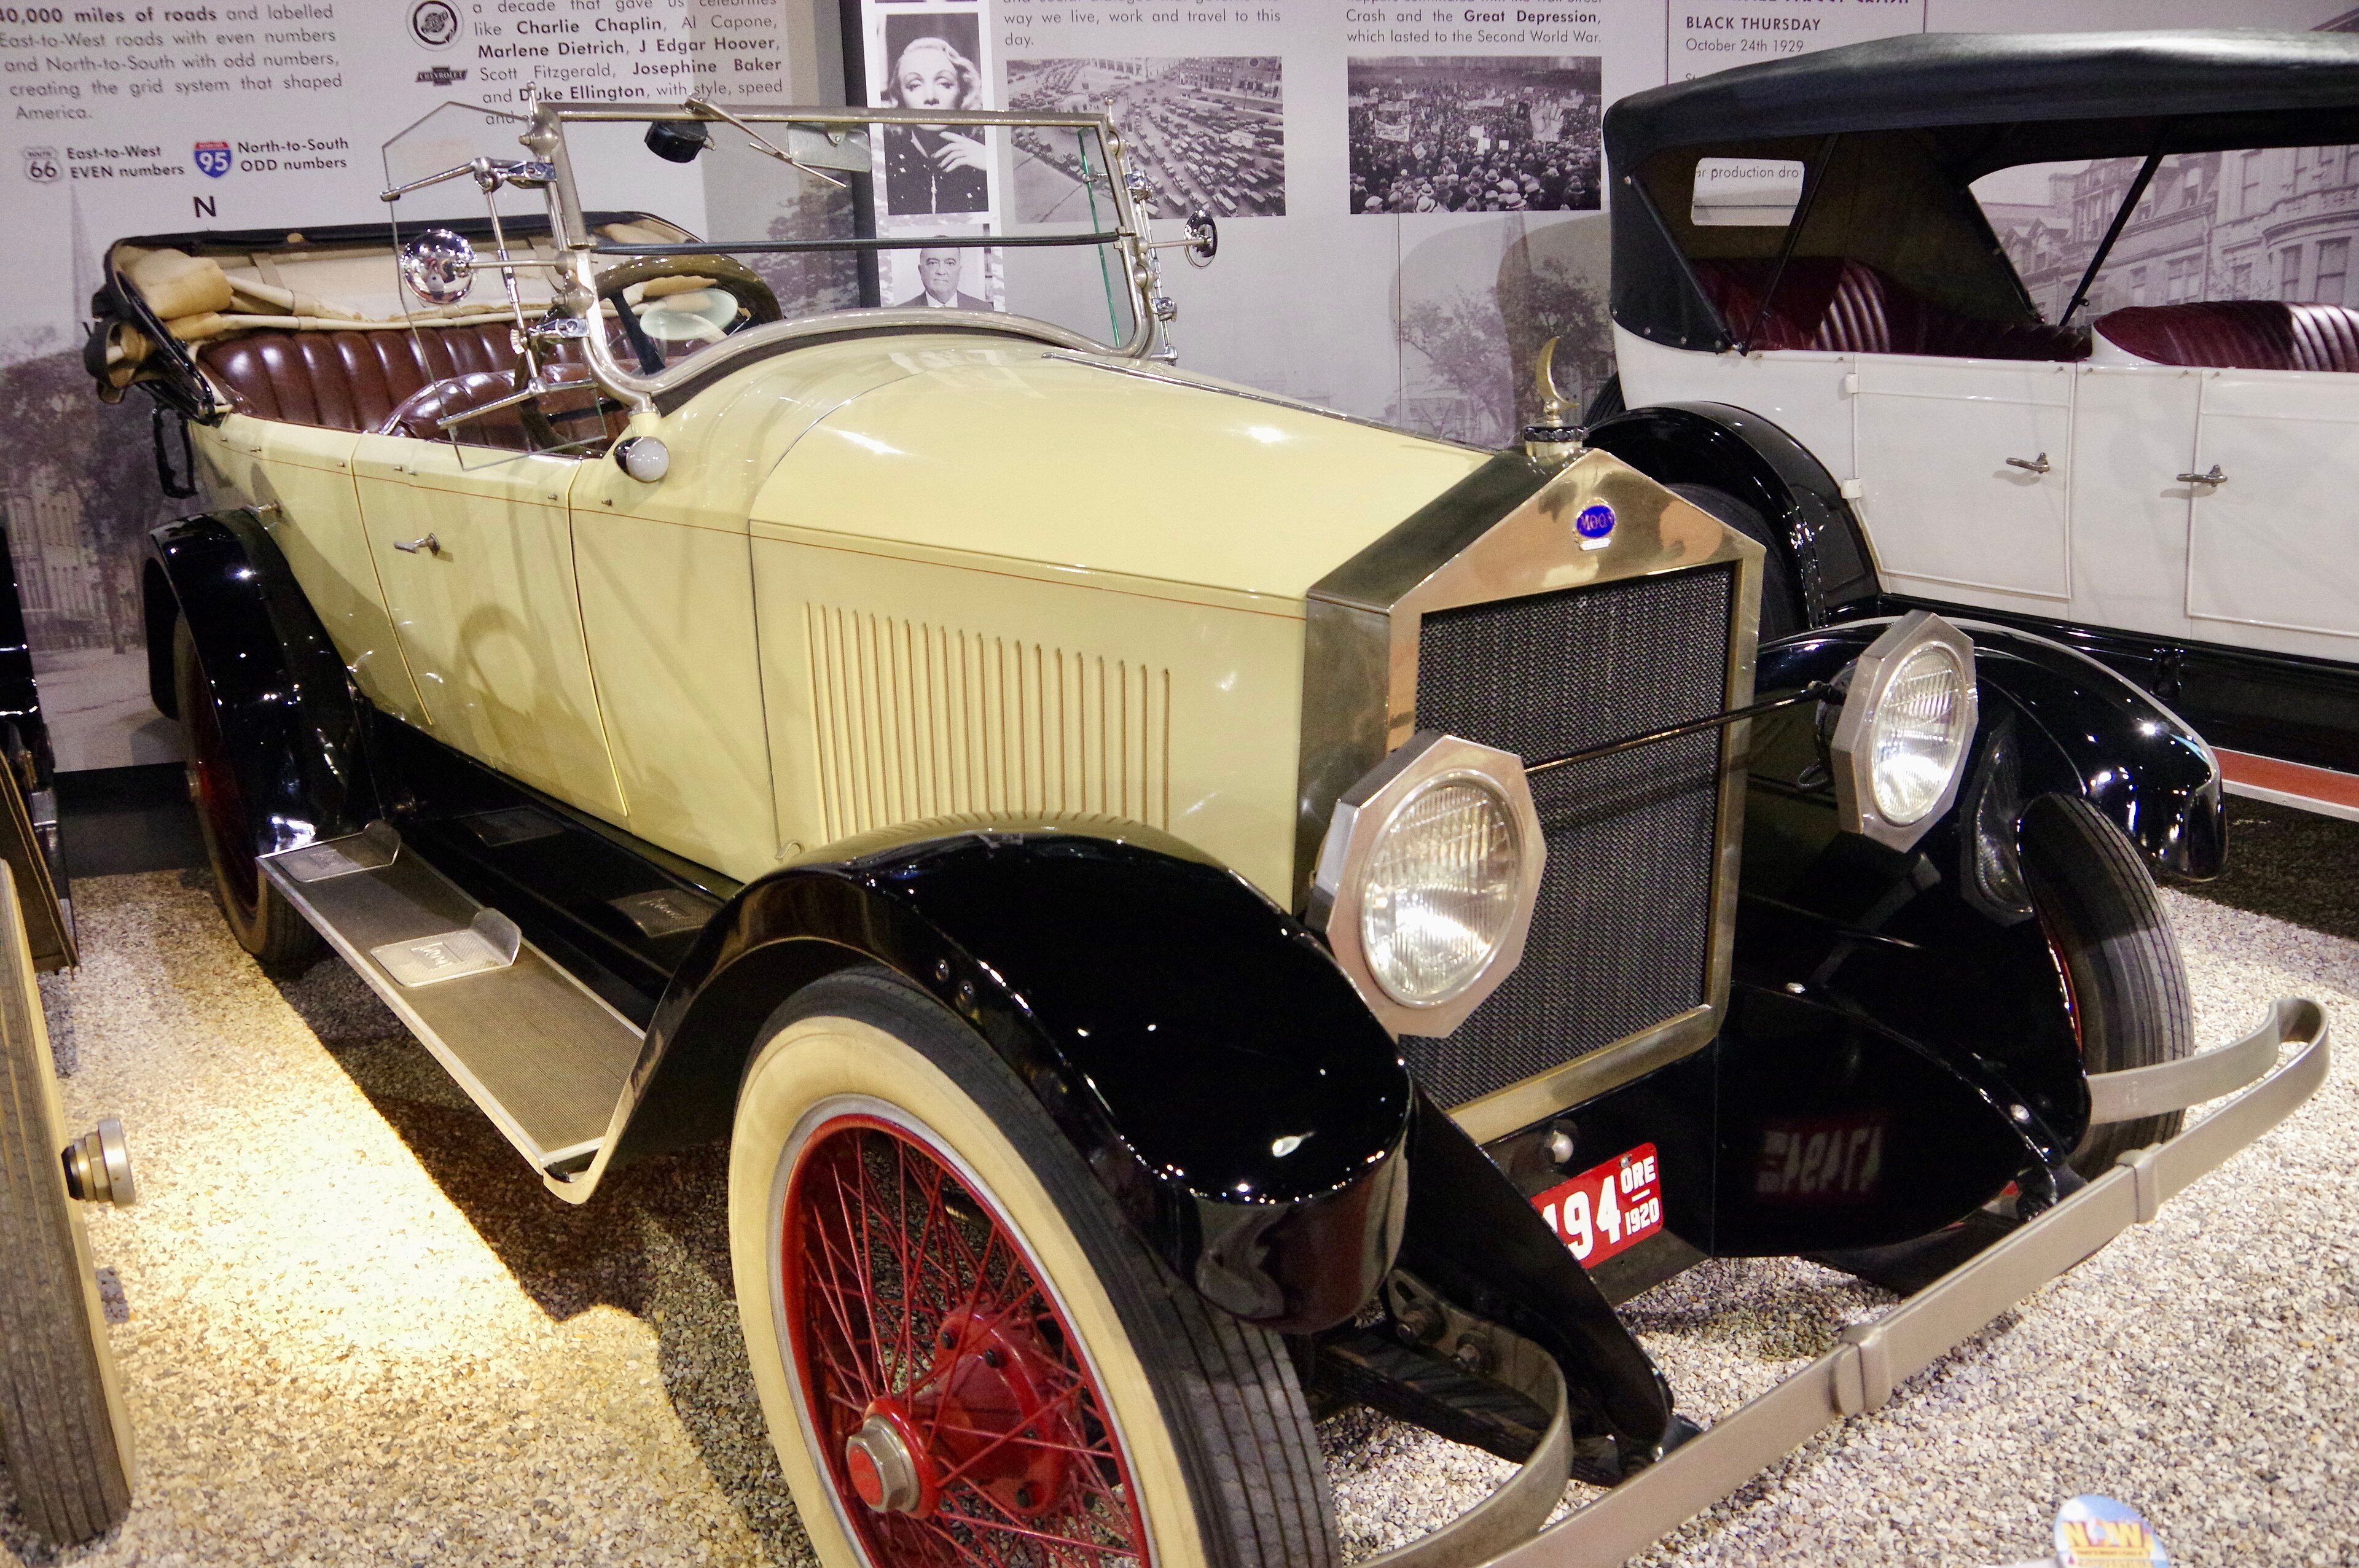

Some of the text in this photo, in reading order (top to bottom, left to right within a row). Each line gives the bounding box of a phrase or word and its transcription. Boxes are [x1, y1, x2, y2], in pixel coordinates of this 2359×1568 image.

[75, 8, 125, 23] miles
[136, 7, 152, 22] of
[165, 6, 216, 21] roads
[226, 5, 258, 21] and
[268, 4, 333, 20] labelled
[472, 4, 482, 14] a
[498, 0, 555, 12] decade
[616, 0, 652, 12] gave
[474, 14, 777, 36] like Charlie Chaplin, Al Capone,
[1004, 9, 1280, 26] way we live, work and travel to this
[1346, 9, 1600, 25] Crash and the Great Depression,
[1686, 17, 1820, 31] BLACK THURSDAY
[115, 31, 163, 47] roads
[173, 30, 206, 44] with
[216, 34, 254, 44] even
[265, 28, 336, 43] numbers
[1005, 32, 1033, 49] day.
[1347, 29, 1601, 43] which lasted to the Second World War.
[1686, 37, 1804, 52] October 24th 1929
[479, 37, 779, 58] Marlene Dietrich, J Edgar Hoover,
[4, 51, 338, 72] and North-to-South with odd numbers,
[480, 58, 781, 83] Scott Fitzgerald, Josephine Baker
[10, 73, 342, 99] creating the grid system that shaped
[482, 78, 783, 104] and Duke Ellington, with style, speed
[16, 105, 92, 120] America.
[67, 146, 160, 160] East-to-West
[238, 137, 348, 153] North-to-South
[31, 161, 57, 177] 66
[200, 152, 229, 171] 95
[241, 157, 346, 172] ODD numbers
[71, 164, 184, 179] EVEN numbers
[1711, 165, 1775, 181] production
[194, 196, 216, 217] N
[1621, 1155, 1656, 1194] ORE
[1625, 1197, 1660, 1236] 1920
